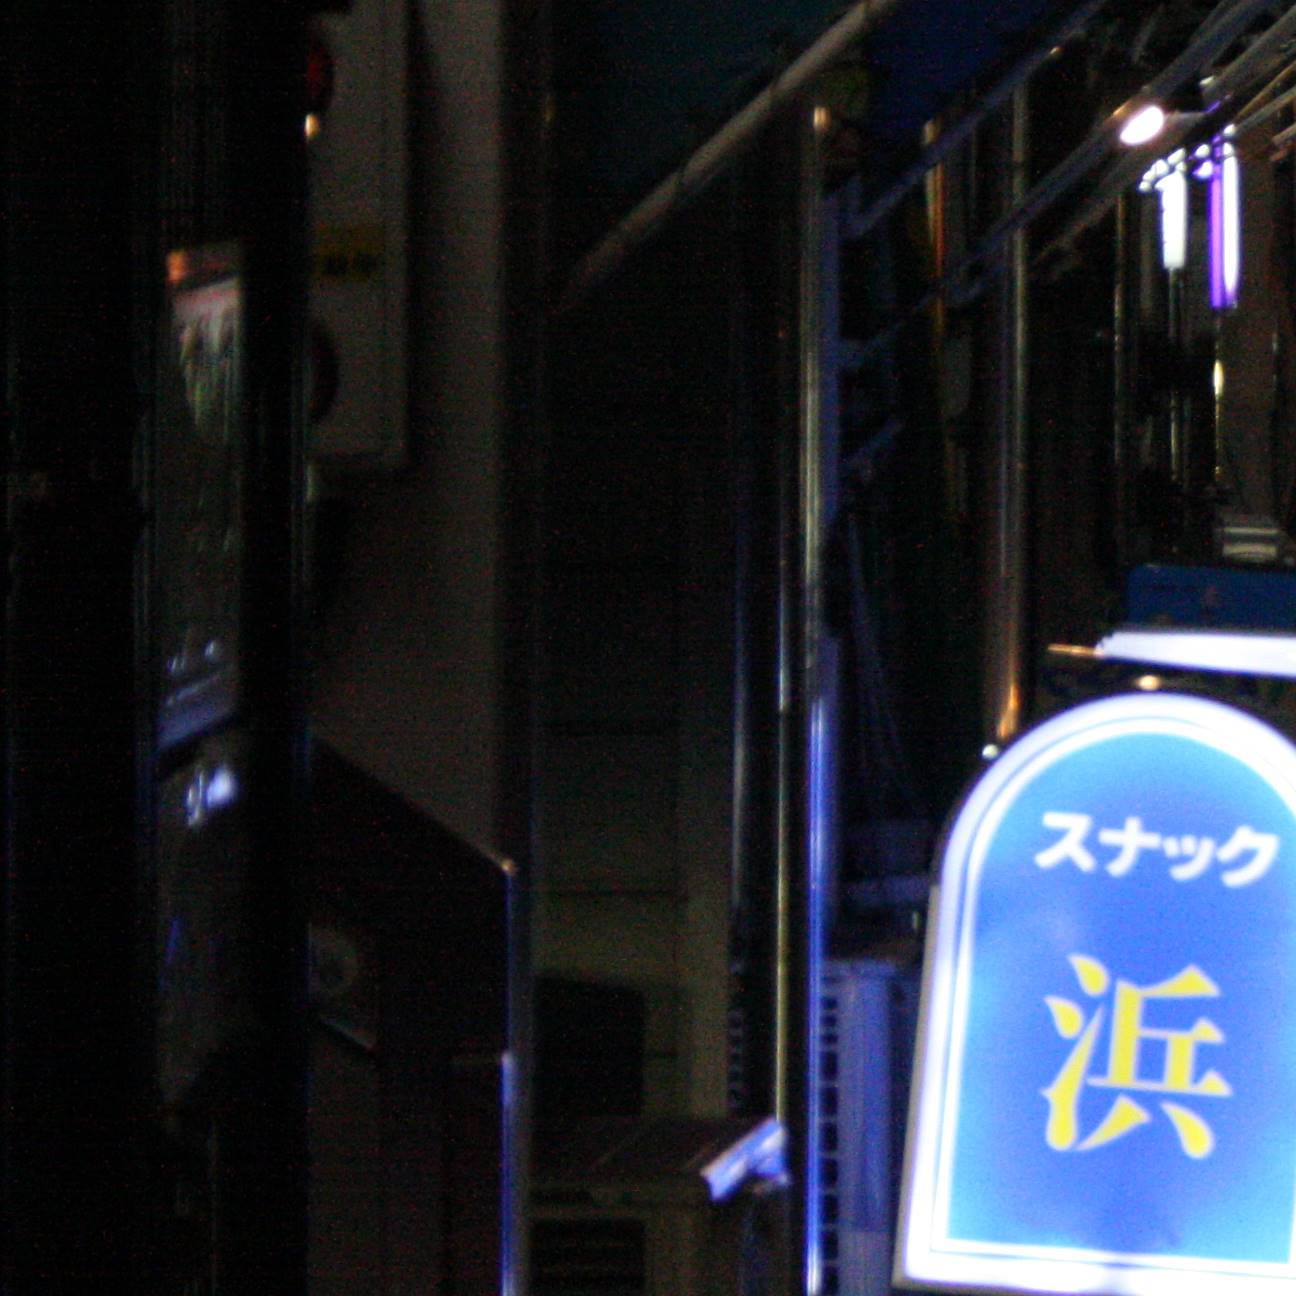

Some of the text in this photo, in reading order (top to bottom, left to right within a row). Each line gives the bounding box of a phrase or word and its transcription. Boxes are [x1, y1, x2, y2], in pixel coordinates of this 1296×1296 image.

[1033, 810, 1281, 888] スナック
[1039, 953, 1234, 1160] 浜
